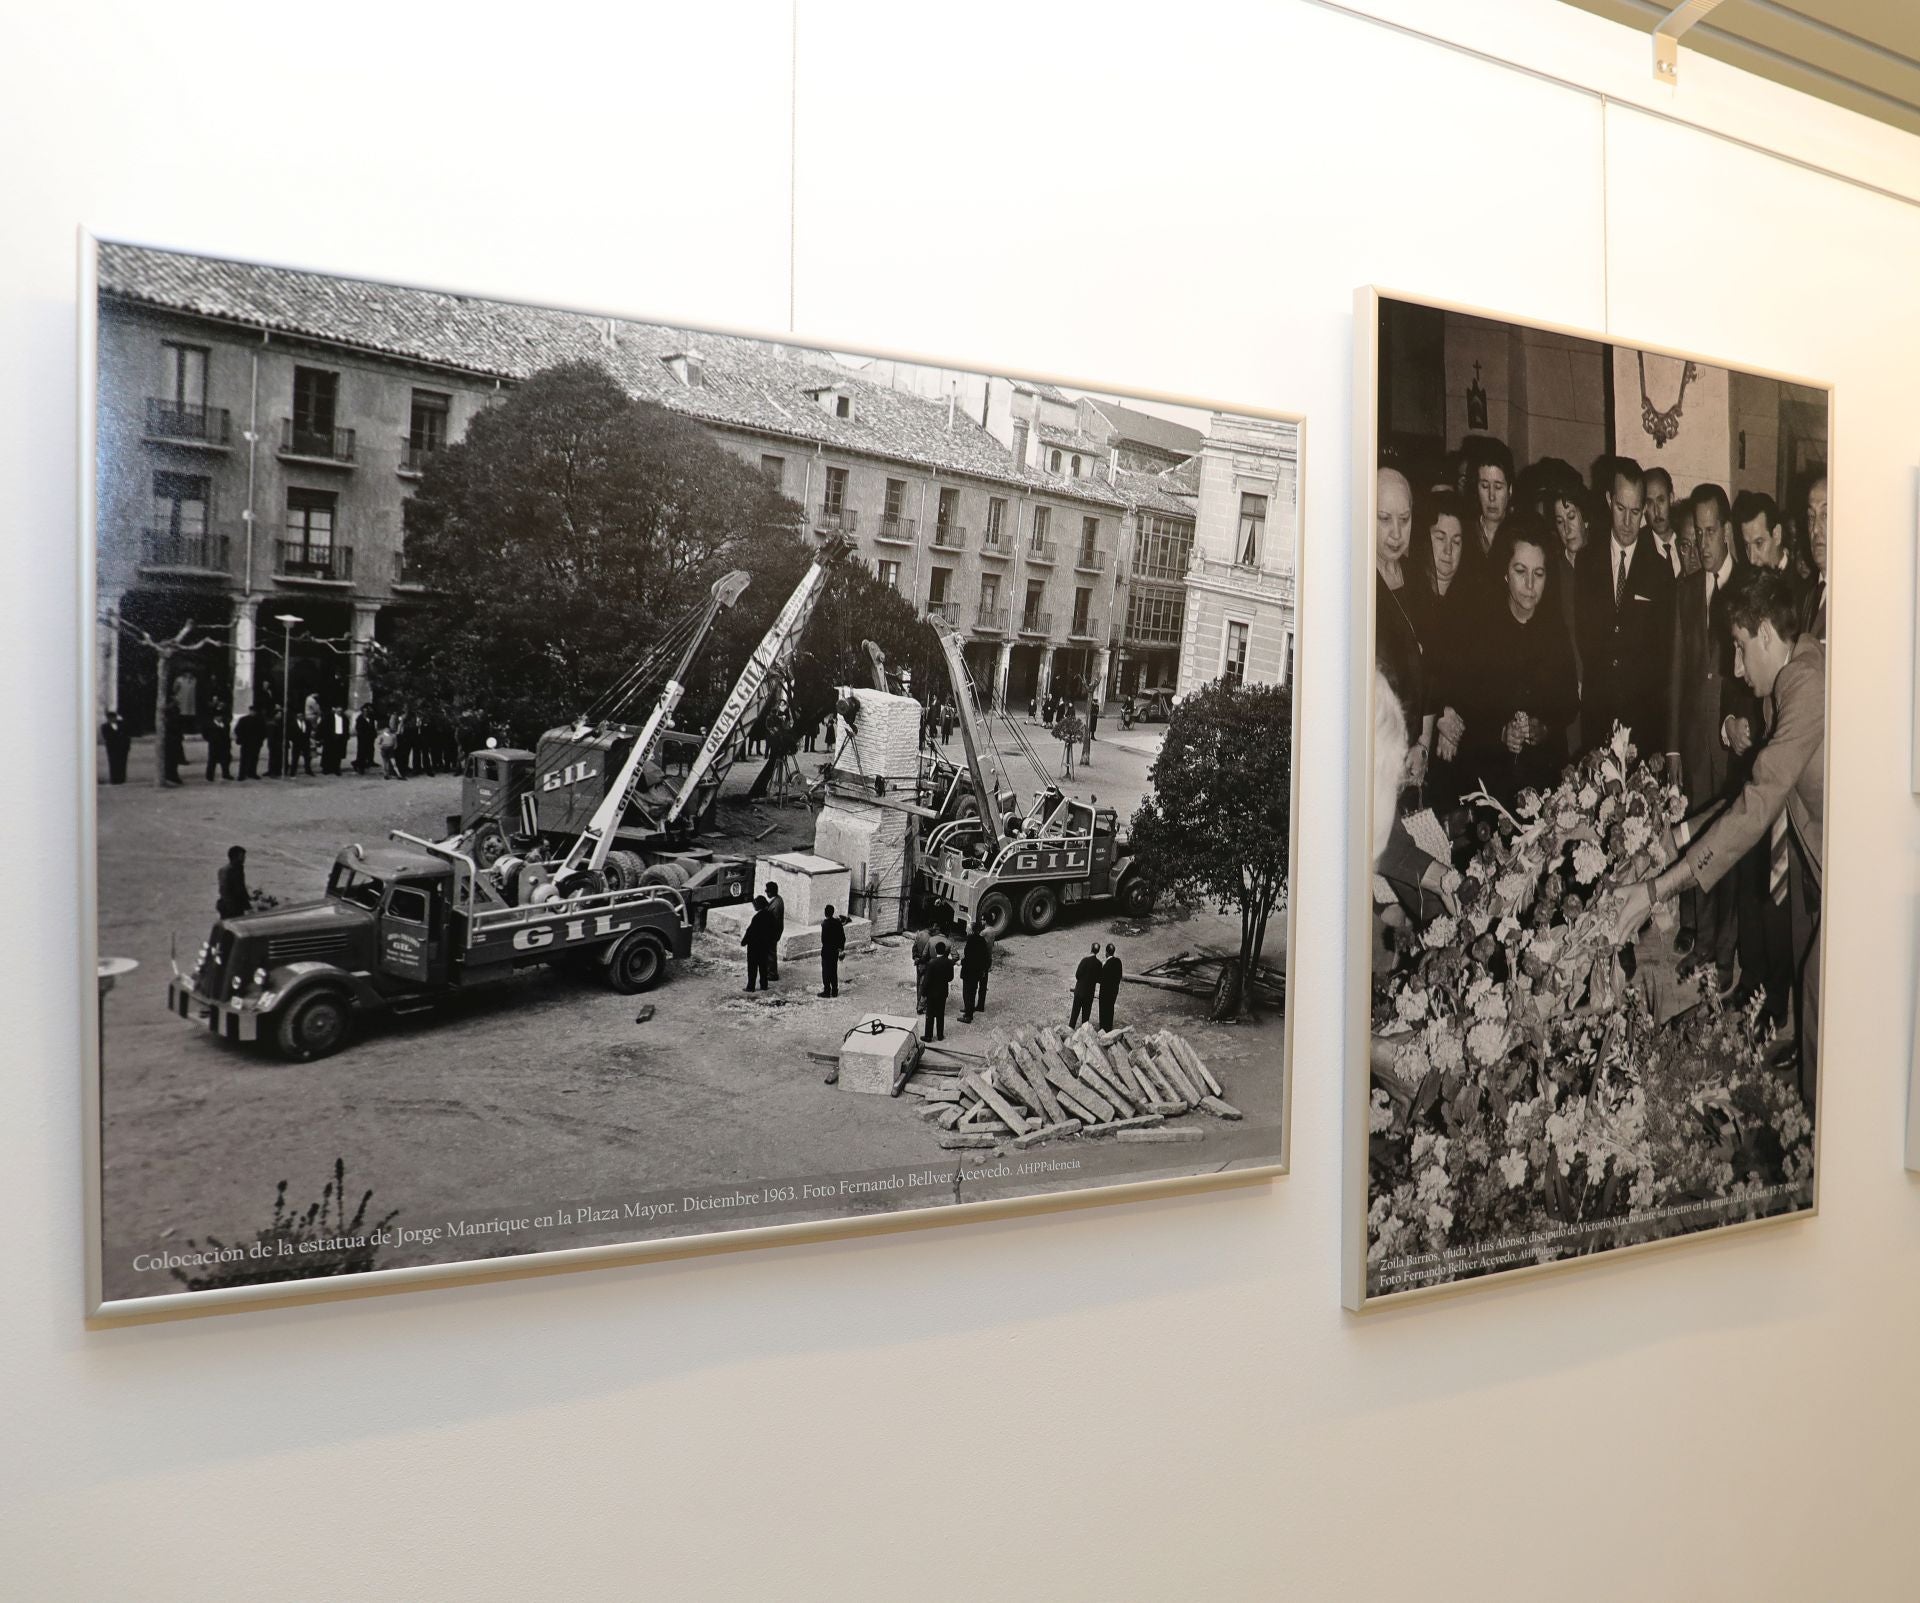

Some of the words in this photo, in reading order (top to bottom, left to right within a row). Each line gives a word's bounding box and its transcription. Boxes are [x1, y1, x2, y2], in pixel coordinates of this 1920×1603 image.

[706, 697, 741, 754] GRUAS
[543, 761, 597, 793] GIL
[1016, 851, 1085, 870] GIL
[512, 914, 632, 950] GIL
[132, 1246, 245, 1273] Colocación
[250, 1241, 273, 1259] de
[278, 1238, 294, 1256] la
[299, 1235, 366, 1254] estatua
[370, 1227, 392, 1246] de
[394, 1224, 442, 1249] Jorge
[447, 1218, 530, 1237] Manrique
[534, 1214, 553, 1228] en
[558, 1209, 572, 1226] la
[577, 1206, 619, 1224] Plaza
[624, 1202, 679, 1220] Mayor.
[683, 1194, 760, 1213] Diciembre
[763, 1186, 798, 1202] 1963.
[803, 1184, 836, 1200] Foto
[840, 1175, 905, 1195] Fernando
[908, 1172, 953, 1188] Bellver
[956, 1164, 1013, 1183] Acevedo.
[1017, 1158, 1081, 1175] AHPPalencia
[1380, 1256, 1404, 1272] Zoila
[1468, 1246, 1474, 1258] y
[1476, 1240, 1494, 1254] Luis
[1496, 1235, 1527, 1250] Alonso,
[1567, 1224, 1578, 1236] de
[1578, 1218, 1611, 1234] Victorio
[1692, 1201, 1702, 1212] en
[1702, 1198, 1710, 1209] la
[1380, 1275, 1402, 1287] Foto
[1404, 1264, 1446, 1283] Fernando
[1448, 1259, 1478, 1274] Bellver
